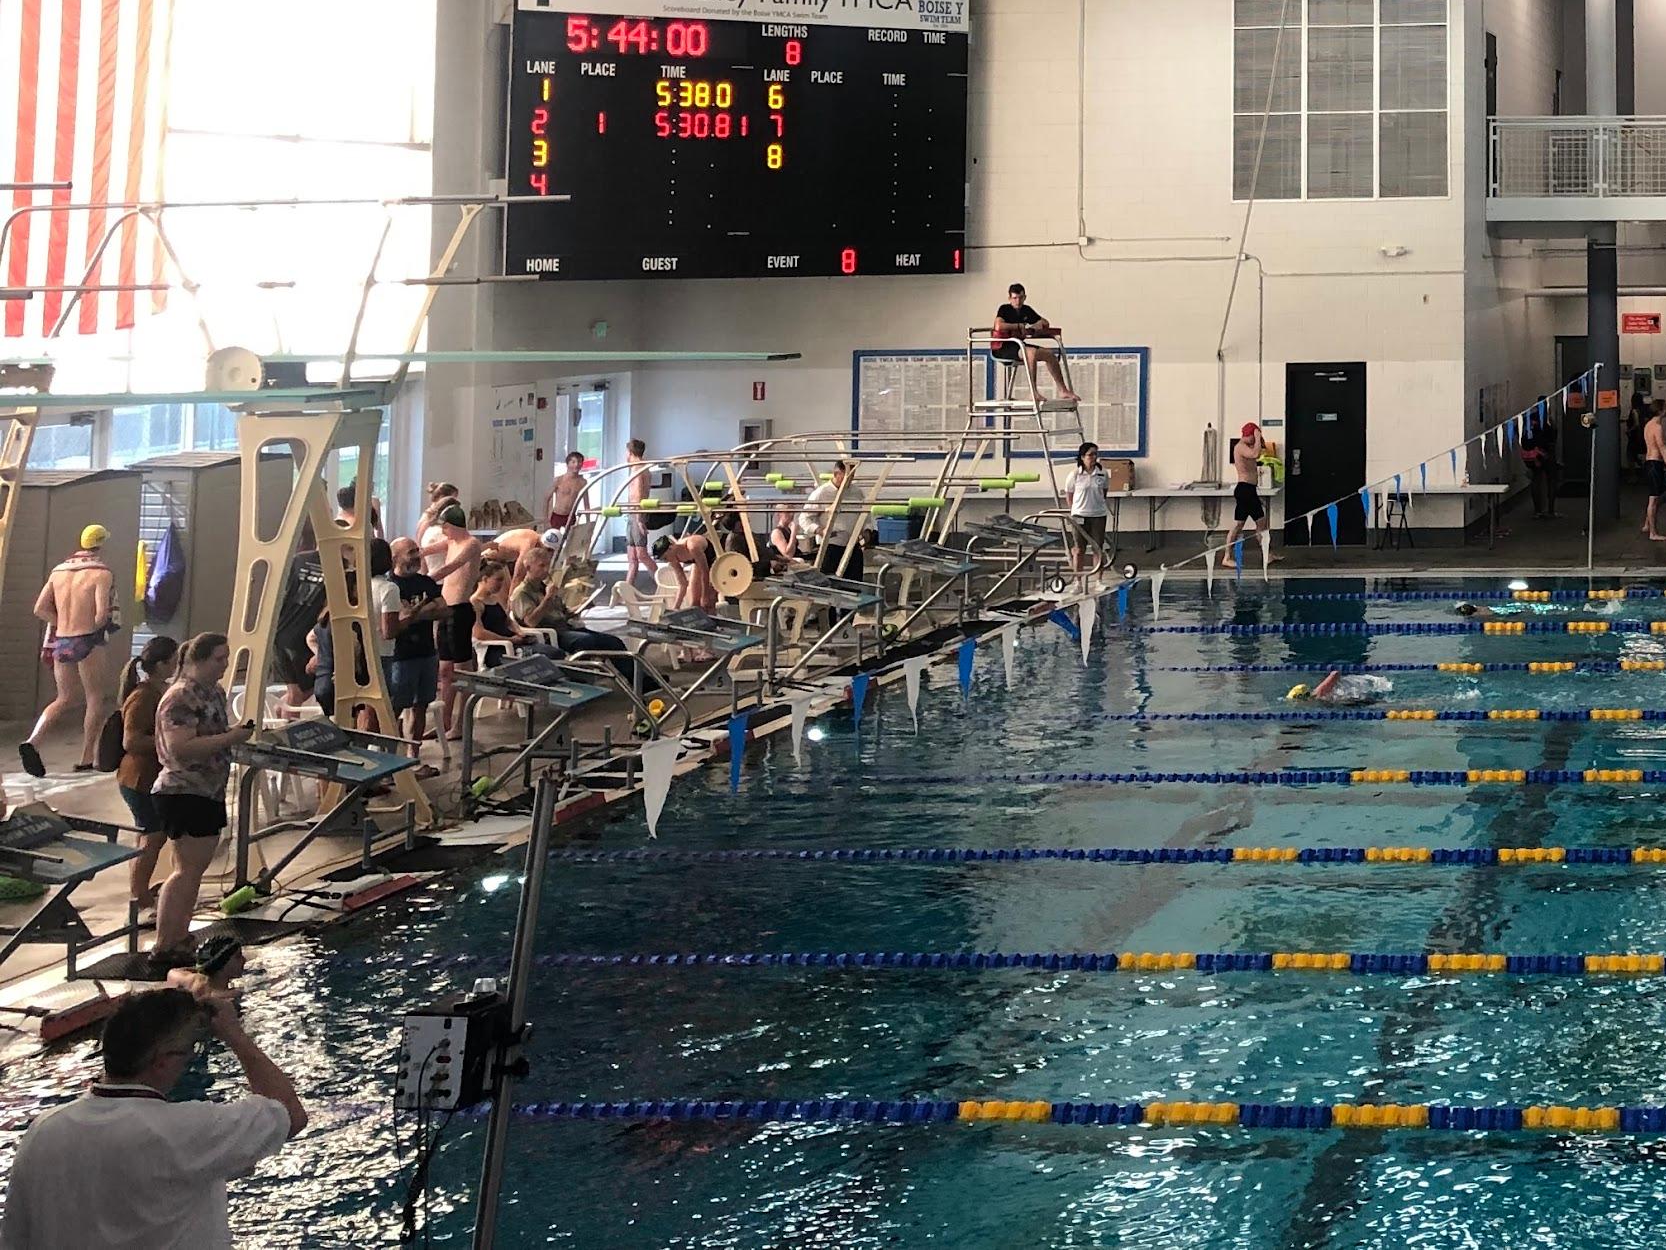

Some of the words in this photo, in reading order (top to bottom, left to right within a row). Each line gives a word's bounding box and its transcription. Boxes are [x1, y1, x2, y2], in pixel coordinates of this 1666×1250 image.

[663, 5, 701, 14] Scoreboard
[702, 7, 731, 15] Donated
[731, 7, 741, 16] by
[741, 8, 752, 16] the
[773, 10, 792, 18] YMCA
[811, 12, 829, 20] Team
[918, 0, 952, 15] BOISE
[955, 2, 964, 15] Y
[919, 14, 940, 23] SWIM
[940, 15, 962, 24] TEAM
[762, 24, 808, 38] LENGTHS
[868, 29, 907, 43] RECORD
[922, 31, 946, 44] TIME
[786, 41, 801, 65] 8
[526, 60, 556, 74] LANE
[580, 62, 616, 76] PLACE
[660, 64, 686, 78] TIME
[763, 69, 790, 82] LANE
[810, 70, 843, 84] PLACE
[882, 73, 906, 86] TIME
[543, 79, 550, 101] 1
[768, 85, 784, 110] 6
[531, 109, 549, 134] 2
[598, 112, 605, 134] 1
[769, 115, 783, 137] 7
[533, 140, 548, 167] 3
[767, 144, 783, 169] 8
[530, 174, 546, 196] 4
[526, 258, 560, 272] HOME
[642, 257, 678, 271] GUEST
[767, 255, 799, 268] EVENT
[841, 249, 854, 273] 8
[896, 253, 921, 266] HEAT
[954, 249, 960, 269] 1
[556, 734, 564, 747] 4
[352, 811, 357, 825] 3
